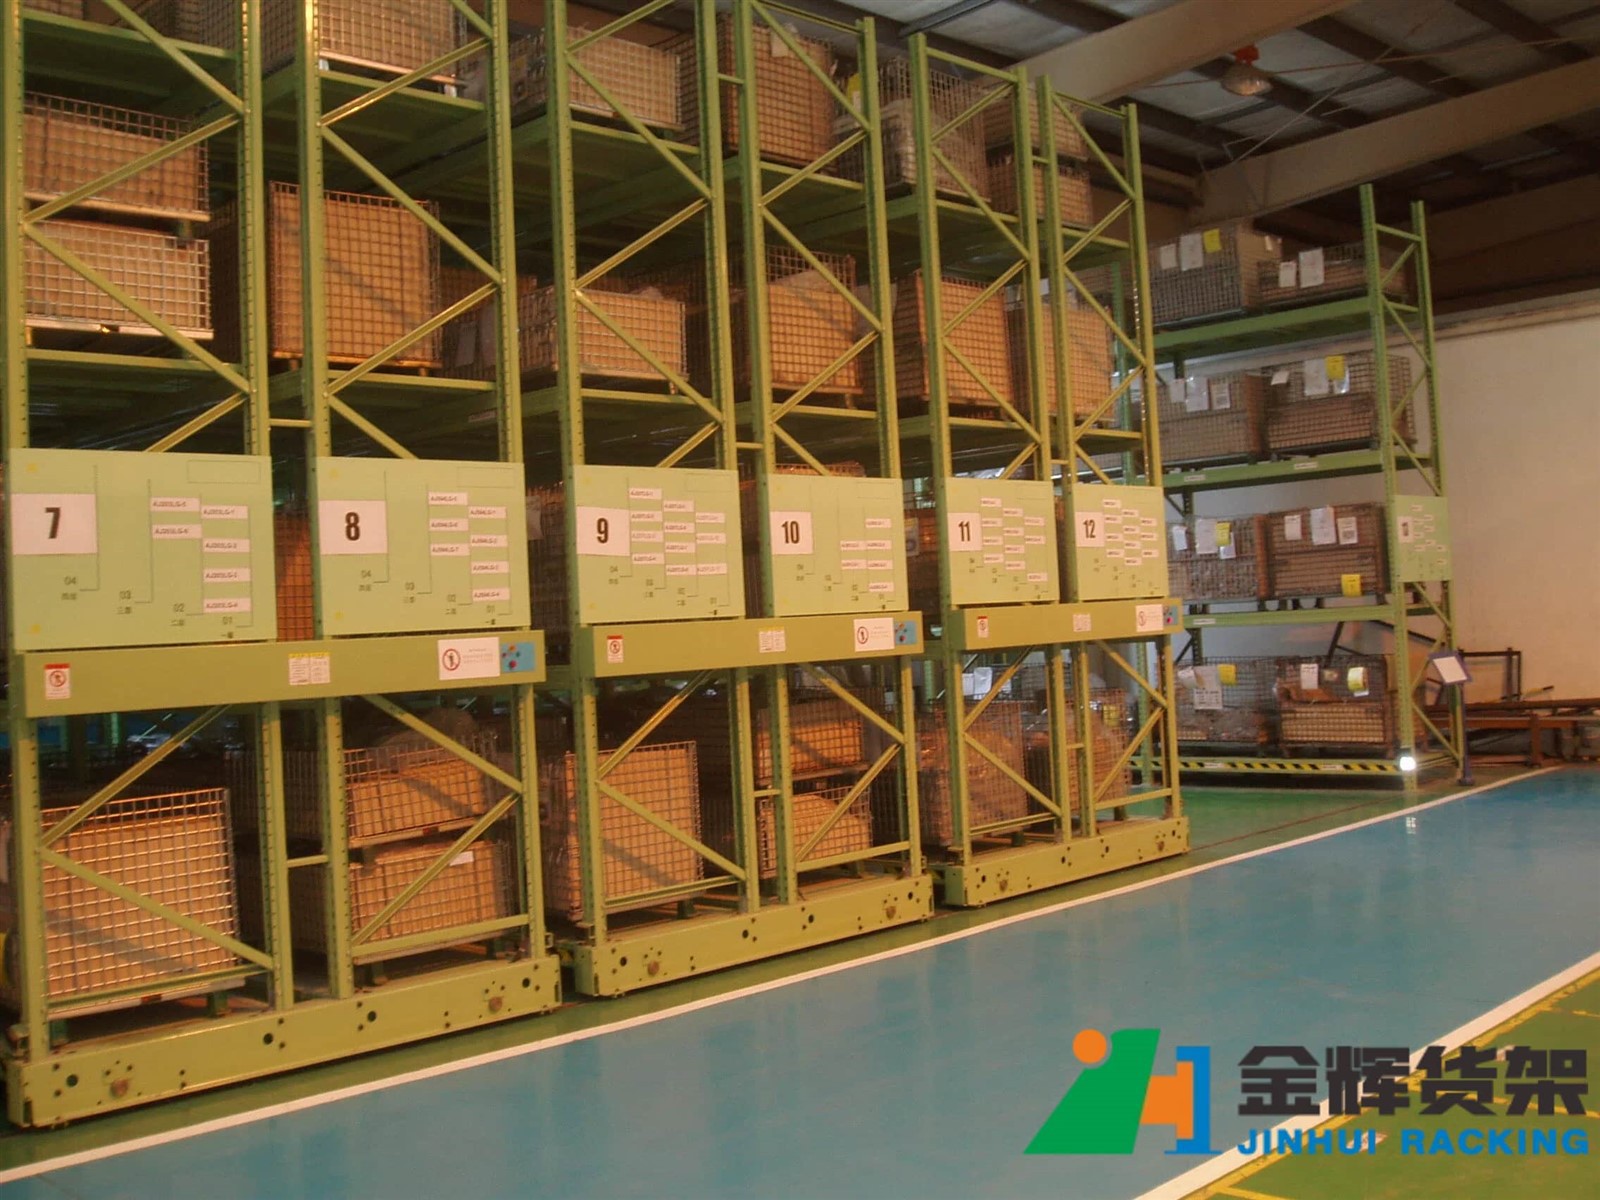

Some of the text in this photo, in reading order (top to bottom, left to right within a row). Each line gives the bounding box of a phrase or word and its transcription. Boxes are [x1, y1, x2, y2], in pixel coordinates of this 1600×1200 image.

[45, 507, 61, 539] 7
[345, 512, 361, 541] 8
[597, 518, 609, 544] 9
[781, 520, 800, 545] 10
[958, 521, 971, 542] 11
[1083, 519, 1096, 539] 12
